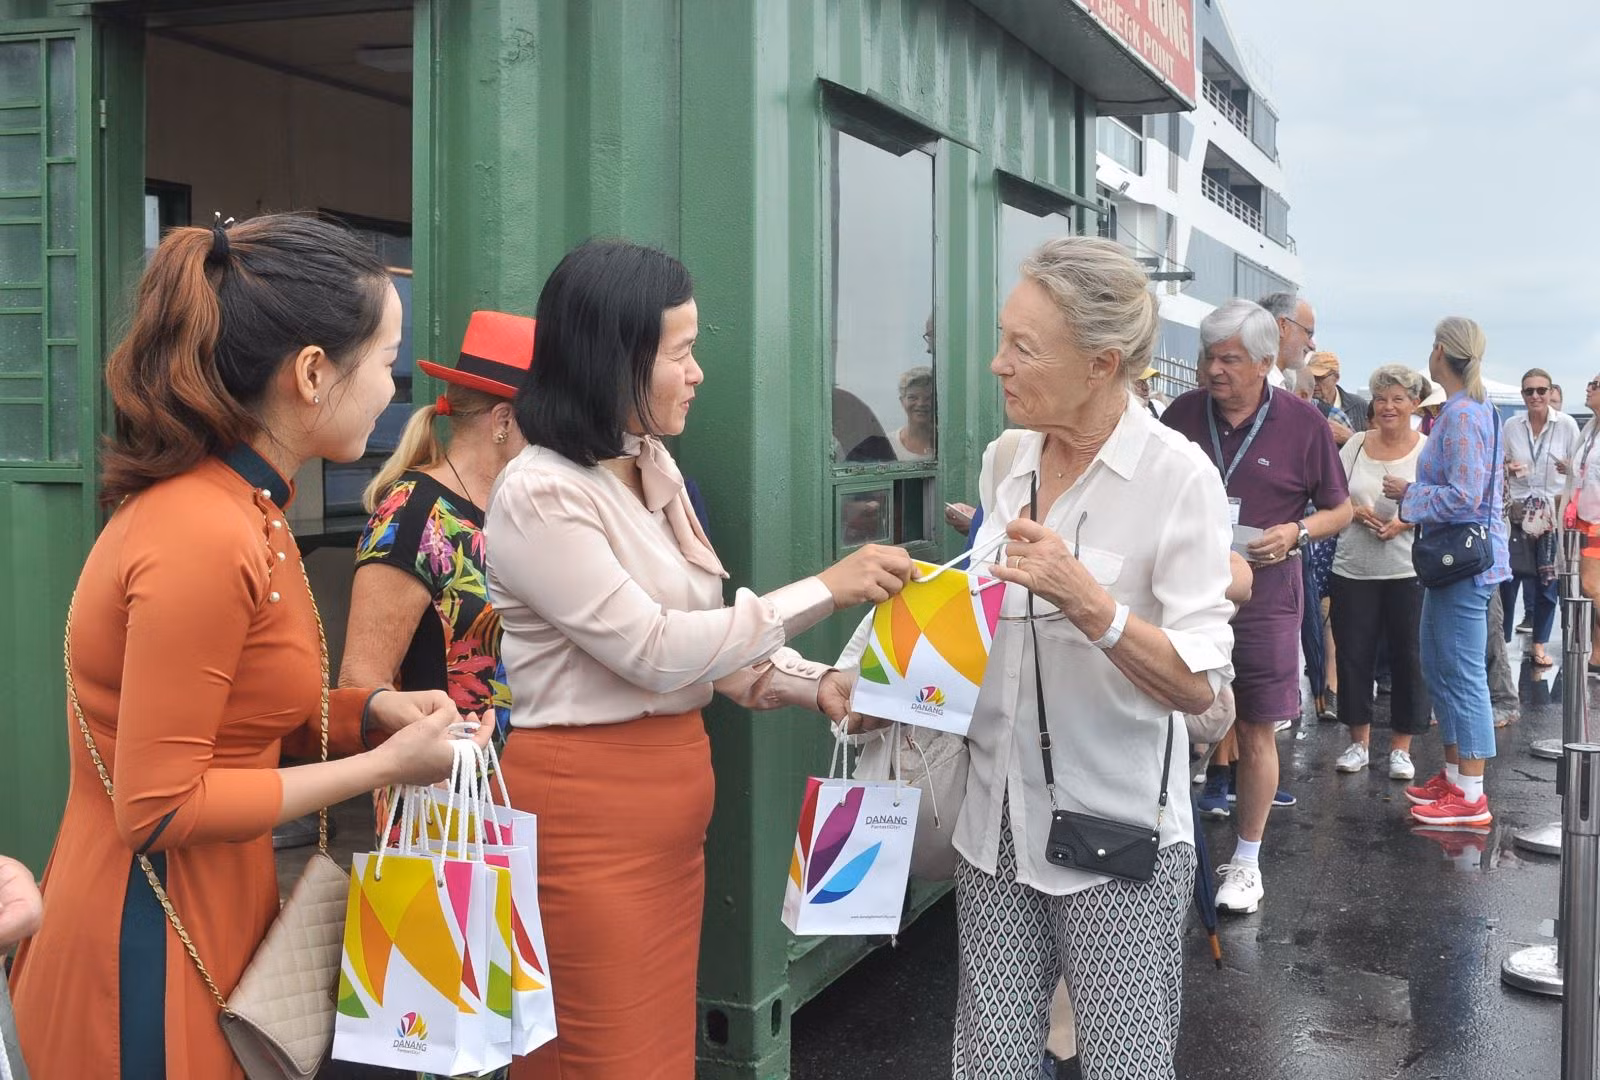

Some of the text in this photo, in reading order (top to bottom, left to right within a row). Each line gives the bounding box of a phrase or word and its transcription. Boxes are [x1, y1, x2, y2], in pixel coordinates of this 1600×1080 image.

[1099, 0, 1175, 80] CHECK POINT
[911, 703, 944, 716] DANANG
[865, 815, 908, 825] DANANG
[392, 1039, 427, 1052] DANANG
